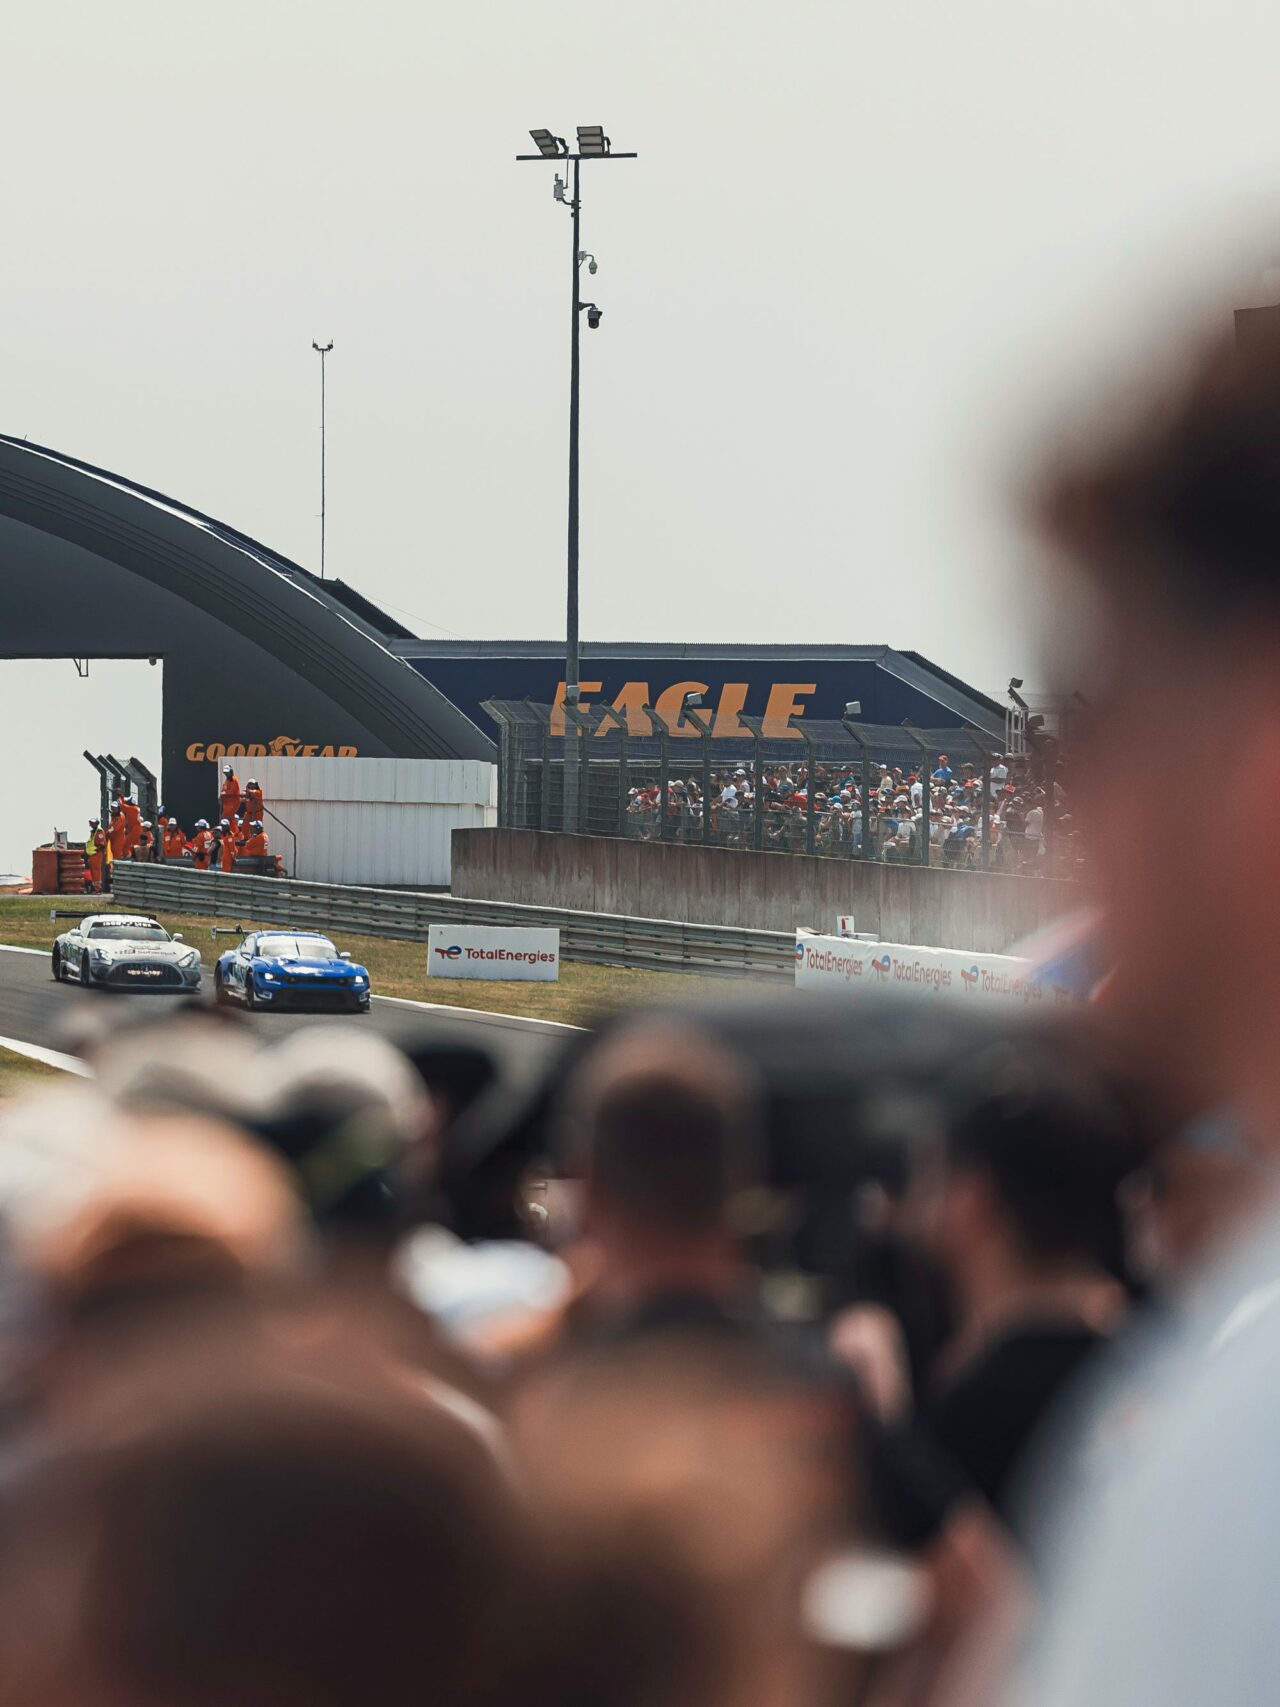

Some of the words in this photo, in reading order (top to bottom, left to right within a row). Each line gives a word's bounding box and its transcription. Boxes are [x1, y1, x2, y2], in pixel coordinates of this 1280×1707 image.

[464, 947, 556, 965] TotalEnergies
[805, 948, 863, 981] TotalEnergies
[892, 959, 952, 990] TotalEnergies
